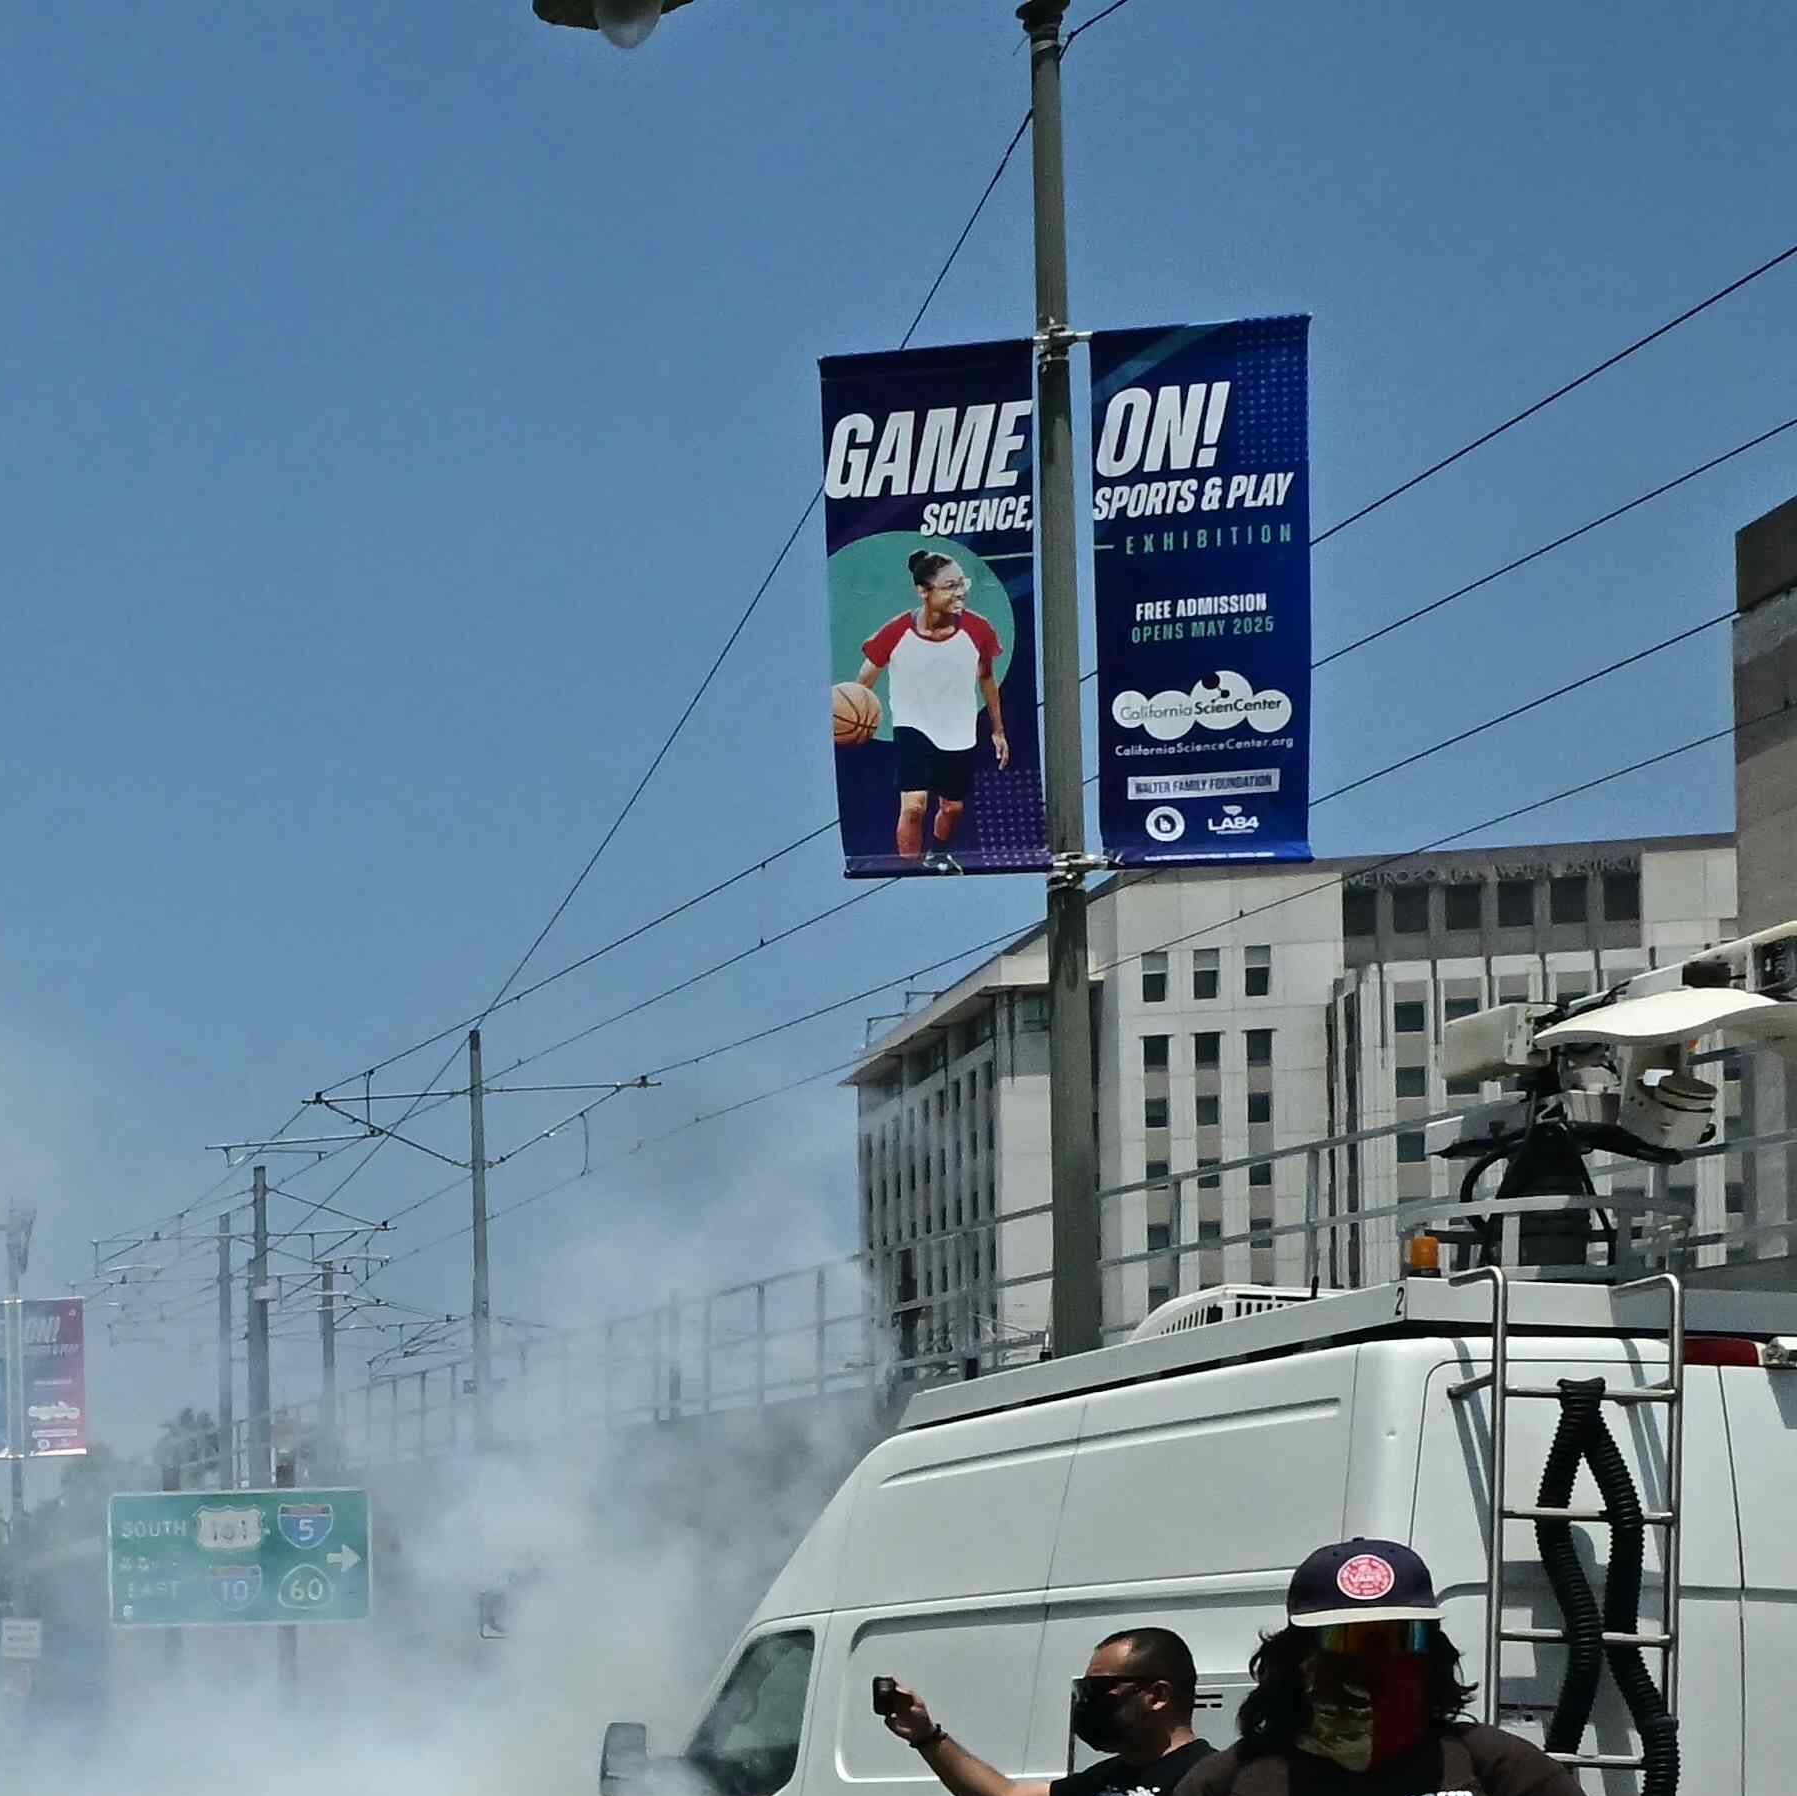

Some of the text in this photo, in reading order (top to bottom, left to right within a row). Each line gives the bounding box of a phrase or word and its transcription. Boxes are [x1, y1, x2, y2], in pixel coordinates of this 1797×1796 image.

[824, 380, 1232, 500] GAME ON!
[1093, 478, 1199, 521] SPORTS
[1201, 476, 1223, 512] &
[1226, 471, 1295, 509] PLAY
[1125, 523, 1293, 555] EXHIBITION
[1135, 592, 1268, 622] FREE ADMISSION
[1130, 615, 1275, 644] OPENS MAY 2025
[1119, 702, 1193, 721] California
[1114, 736, 1294, 758] CaliforniaScienceCenter.org
[1172, 777, 1207, 793] FAMILY
[1209, 773, 1273, 791] FOUNDATION
[121, 1519, 187, 1539] SOUTH
[299, 1518, 315, 1541] 5
[219, 1579, 249, 1601] 10
[289, 1578, 324, 1602] 60
